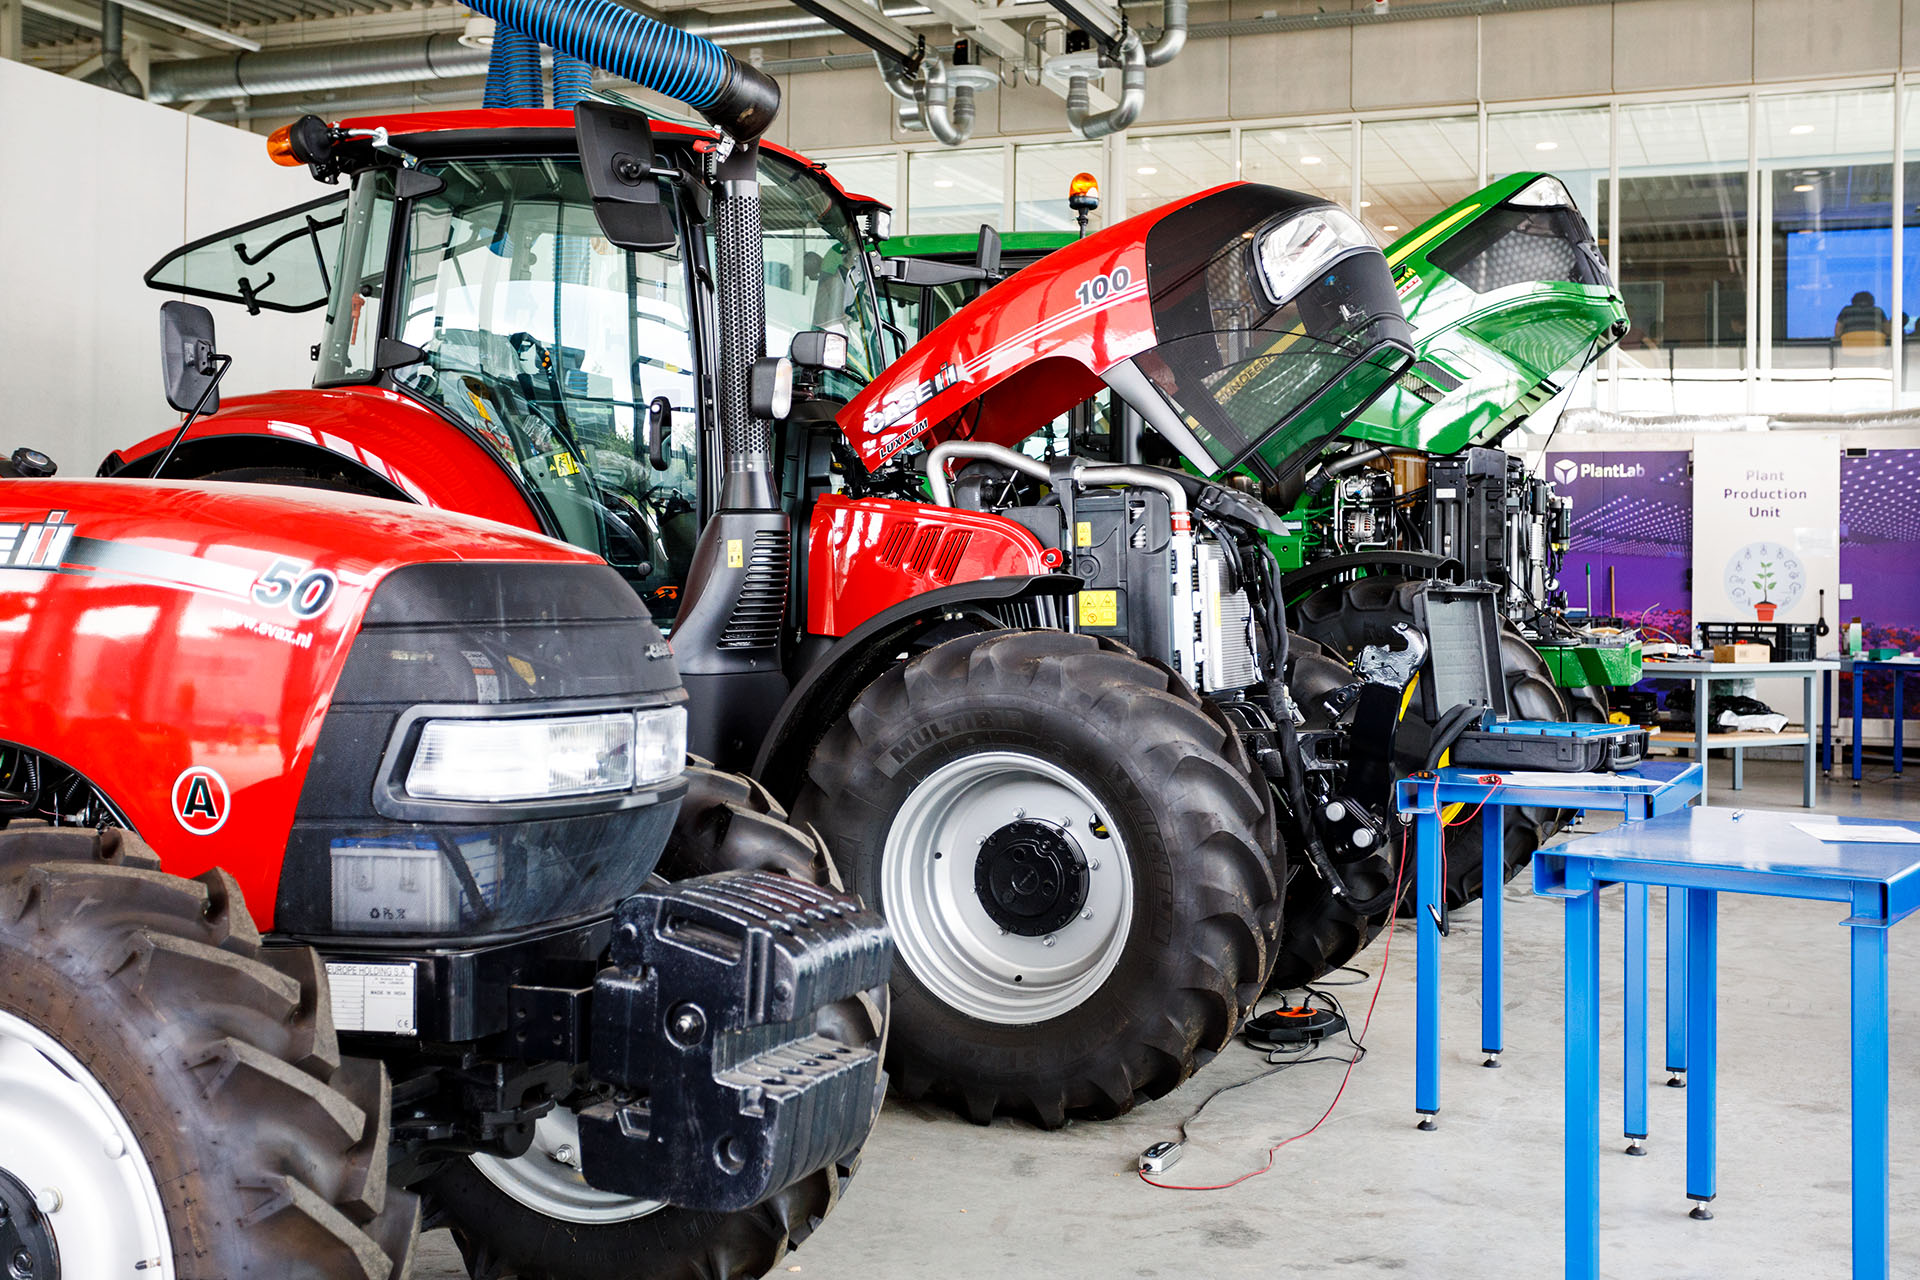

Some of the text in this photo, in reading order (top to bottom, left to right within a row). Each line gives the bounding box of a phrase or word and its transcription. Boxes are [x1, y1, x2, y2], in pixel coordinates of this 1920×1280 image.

[1077, 267, 1129, 307] 100
[867, 379, 934, 434] CASE
[1217, 380, 1241, 403] OHN
[880, 418, 928, 459] LUXXUM
[1581, 463, 1645, 478] PlantLab
[1746, 470, 1784, 481] Plant
[1724, 488, 1807, 499] Production
[1749, 507, 1780, 518] Unit
[253, 557, 338, 619] 50
[223, 608, 313, 649] w.evax.nl
[182, 776, 219, 818] A
[327, 965, 357, 976] EUROPE
[359, 966, 392, 977] HOLDING
